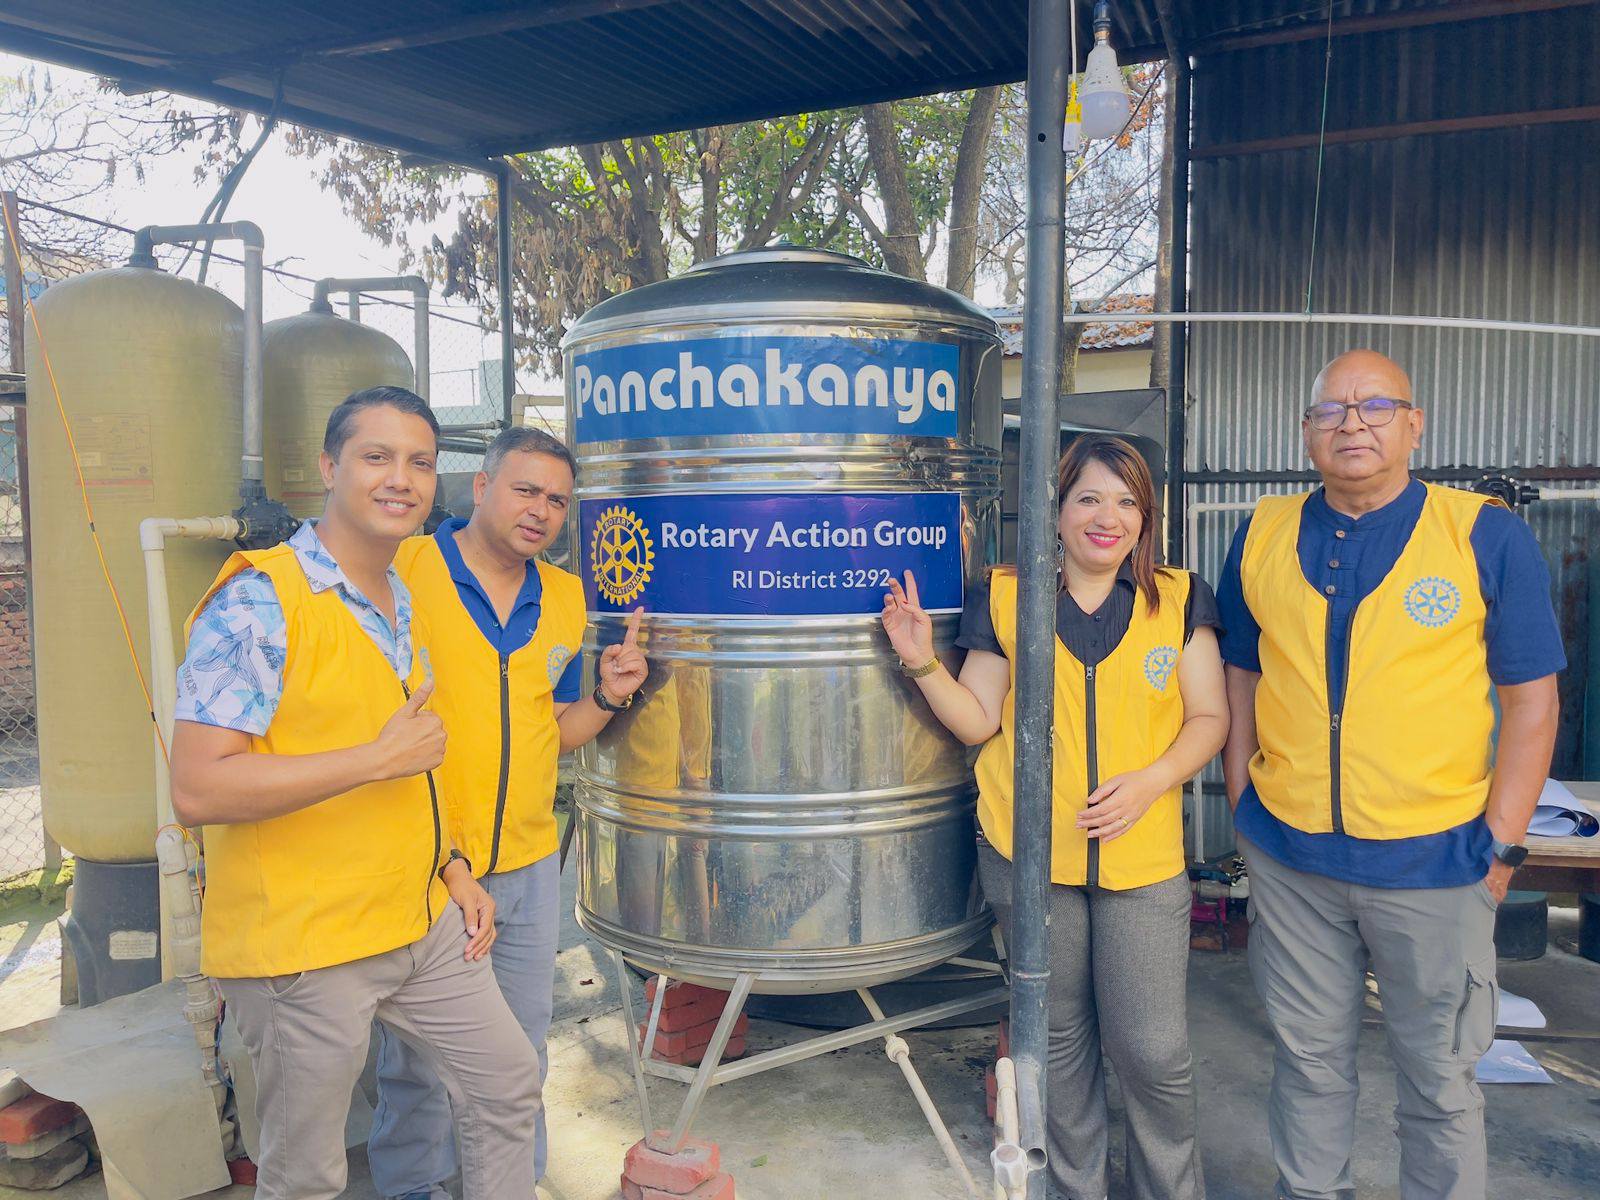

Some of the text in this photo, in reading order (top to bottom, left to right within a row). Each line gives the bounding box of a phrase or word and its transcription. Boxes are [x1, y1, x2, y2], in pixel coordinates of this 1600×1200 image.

[575, 348, 955, 424] Panchakanya
[604, 517, 631, 529] ROTARY
[661, 520, 947, 552] Rotary Action Group
[599, 571, 645, 595] INTERNATIONAL
[732, 568, 890, 589] RI District 3292
